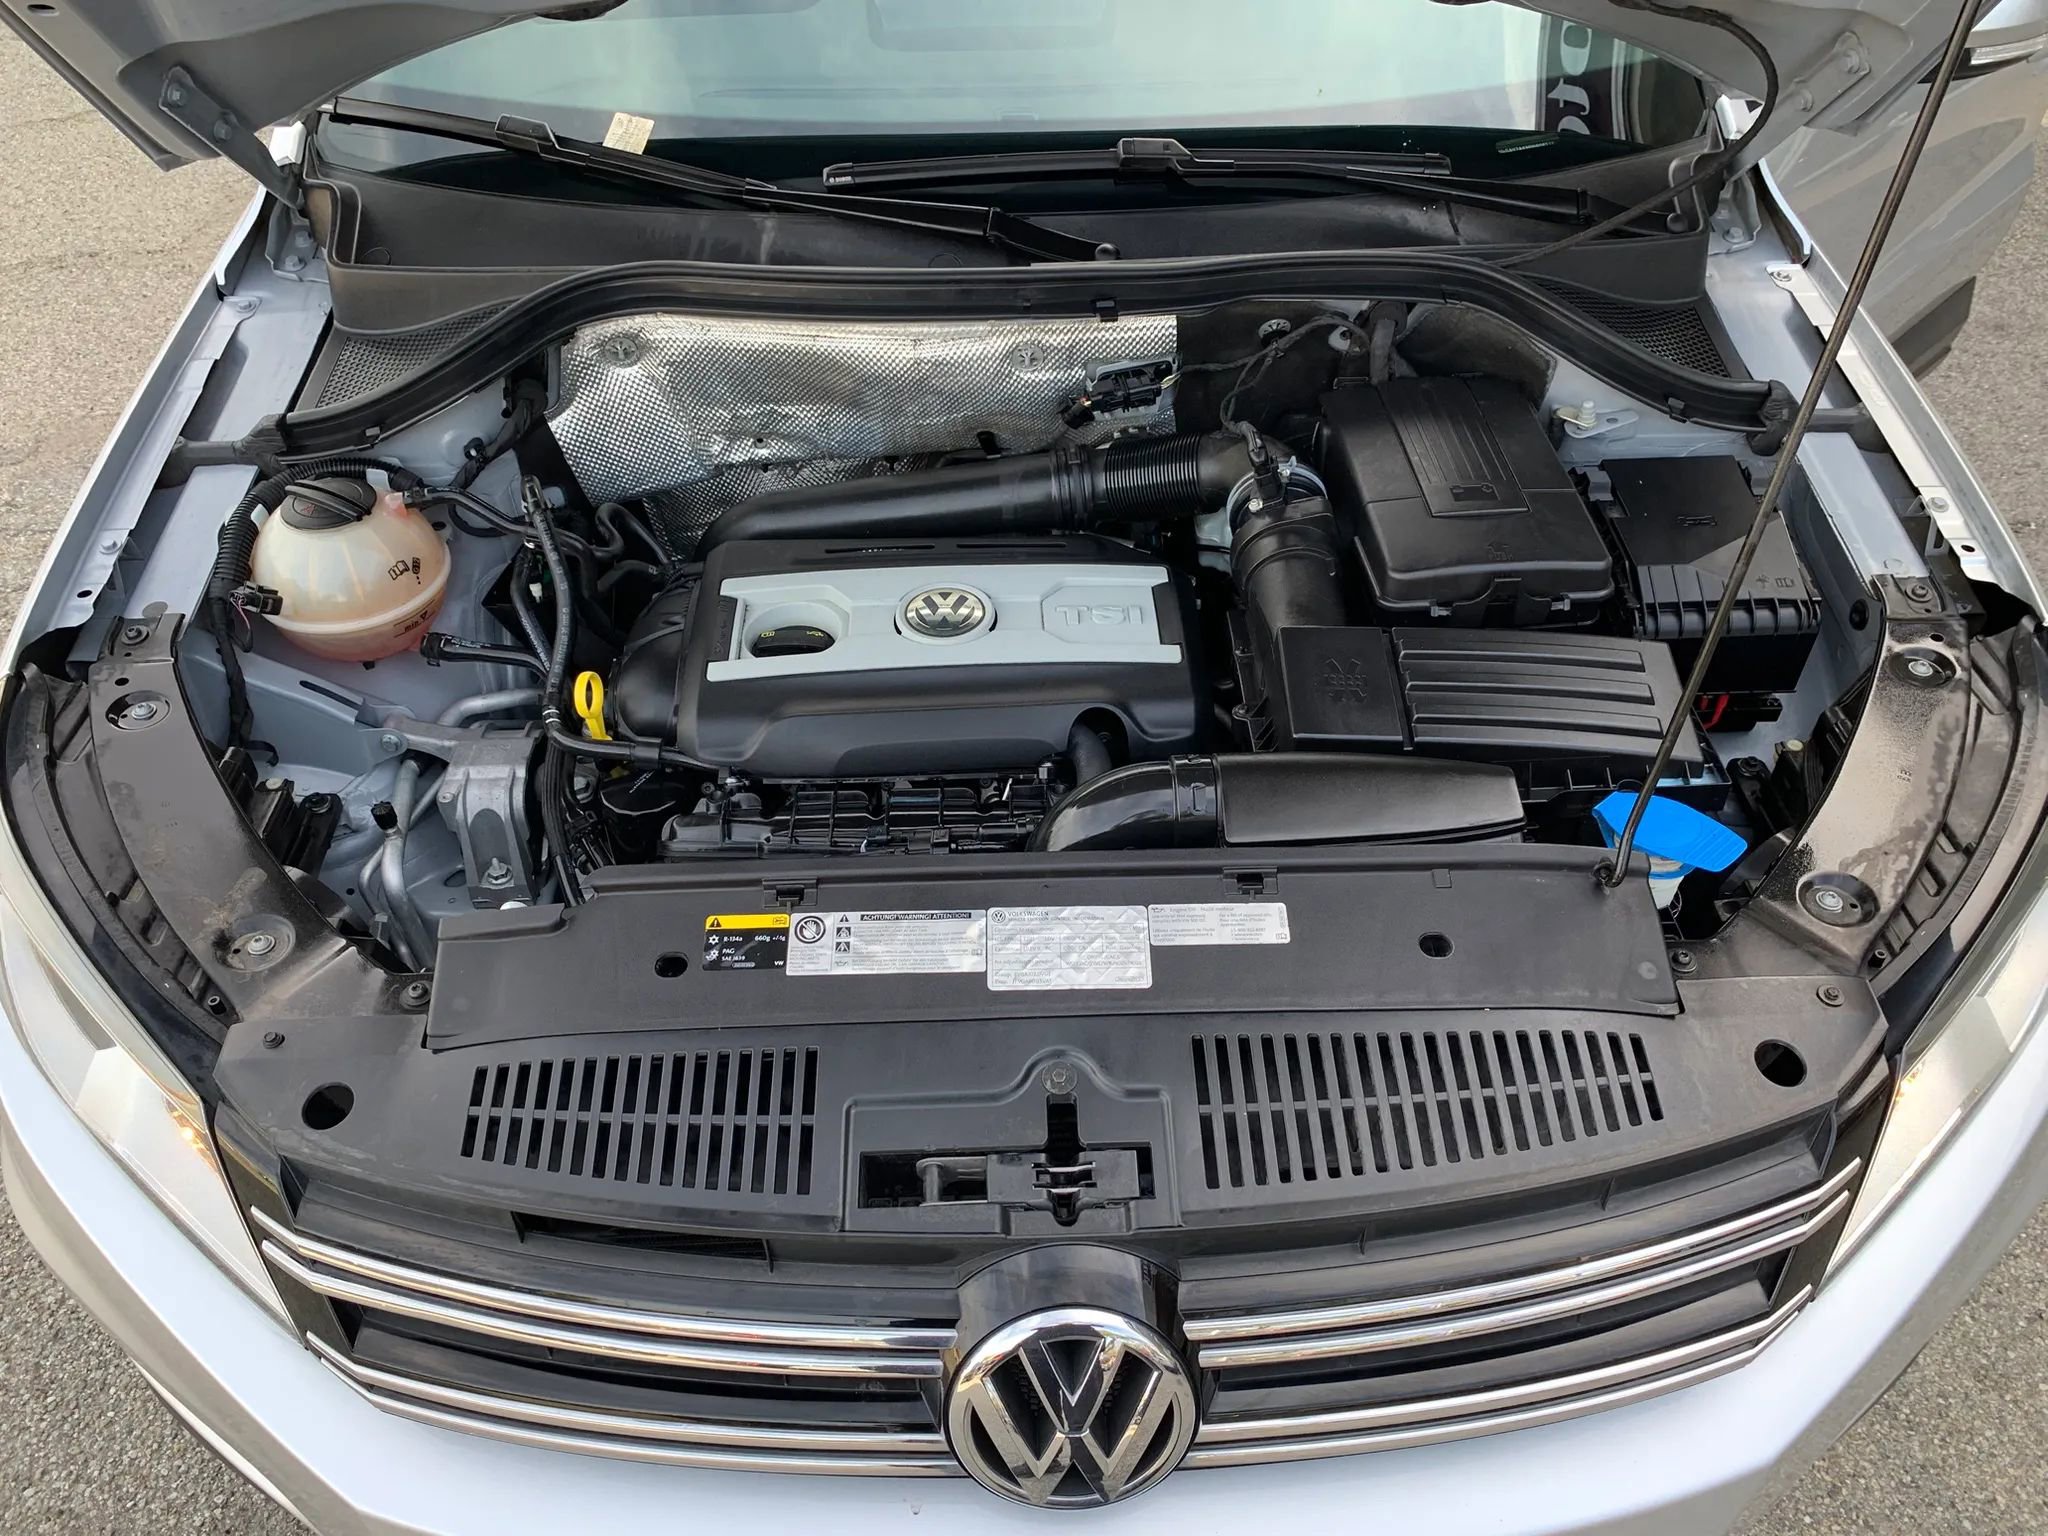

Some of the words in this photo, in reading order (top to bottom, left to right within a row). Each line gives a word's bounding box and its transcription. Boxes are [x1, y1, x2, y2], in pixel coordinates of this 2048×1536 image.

[1055, 605, 1143, 625] TSI
[405, 621, 419, 633] min
[932, 912, 969, 920] ATTENTION!
[754, 935, 771, 943] 660g
[948, 1307, 1198, 1508] VW
